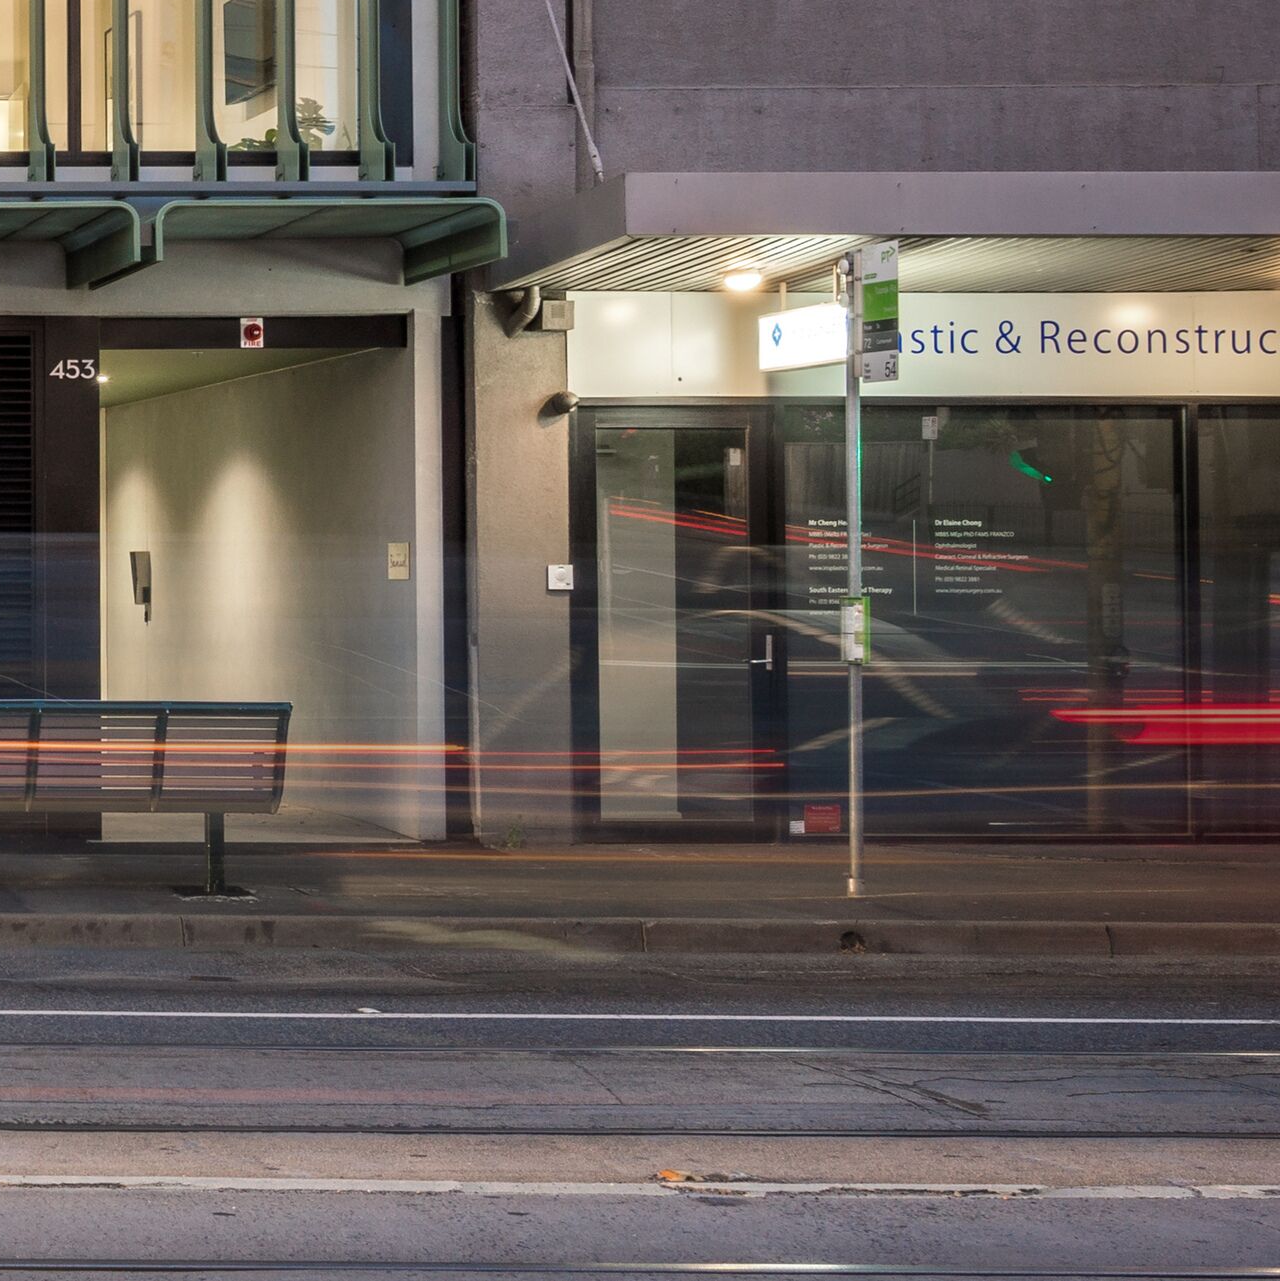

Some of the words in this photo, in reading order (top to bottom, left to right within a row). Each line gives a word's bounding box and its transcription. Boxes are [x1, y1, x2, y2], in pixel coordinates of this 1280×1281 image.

[995, 320, 1022, 354] &
[1040, 321, 1277, 355] Reconstruc
[49, 359, 96, 380] 453
[884, 361, 897, 378] 54
